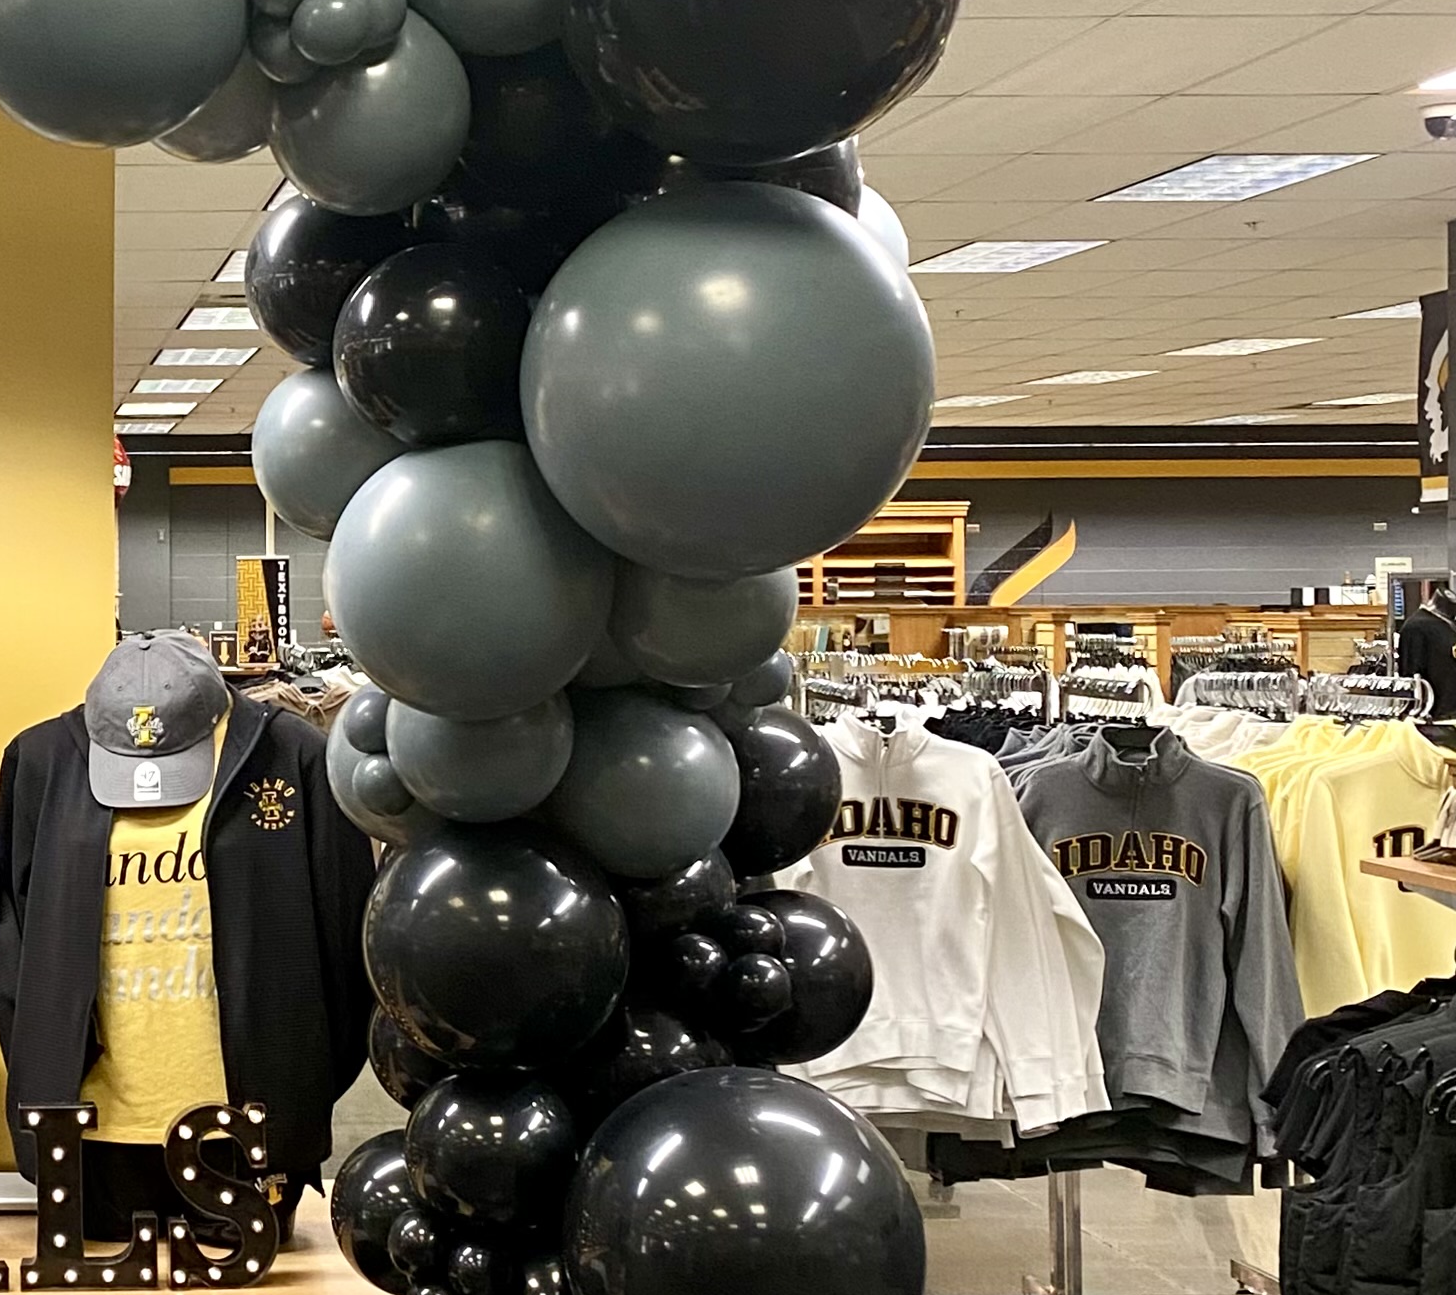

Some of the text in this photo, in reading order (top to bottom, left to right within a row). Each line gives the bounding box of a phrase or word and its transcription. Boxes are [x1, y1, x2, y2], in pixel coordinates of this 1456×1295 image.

[243, 777, 296, 799] IDAHO
[817, 797, 961, 850] DAHO
[847, 848, 920, 864] VANDALS
[1052, 830, 1207, 888] IDAHO
[1092, 881, 1172, 897] VANDALS
